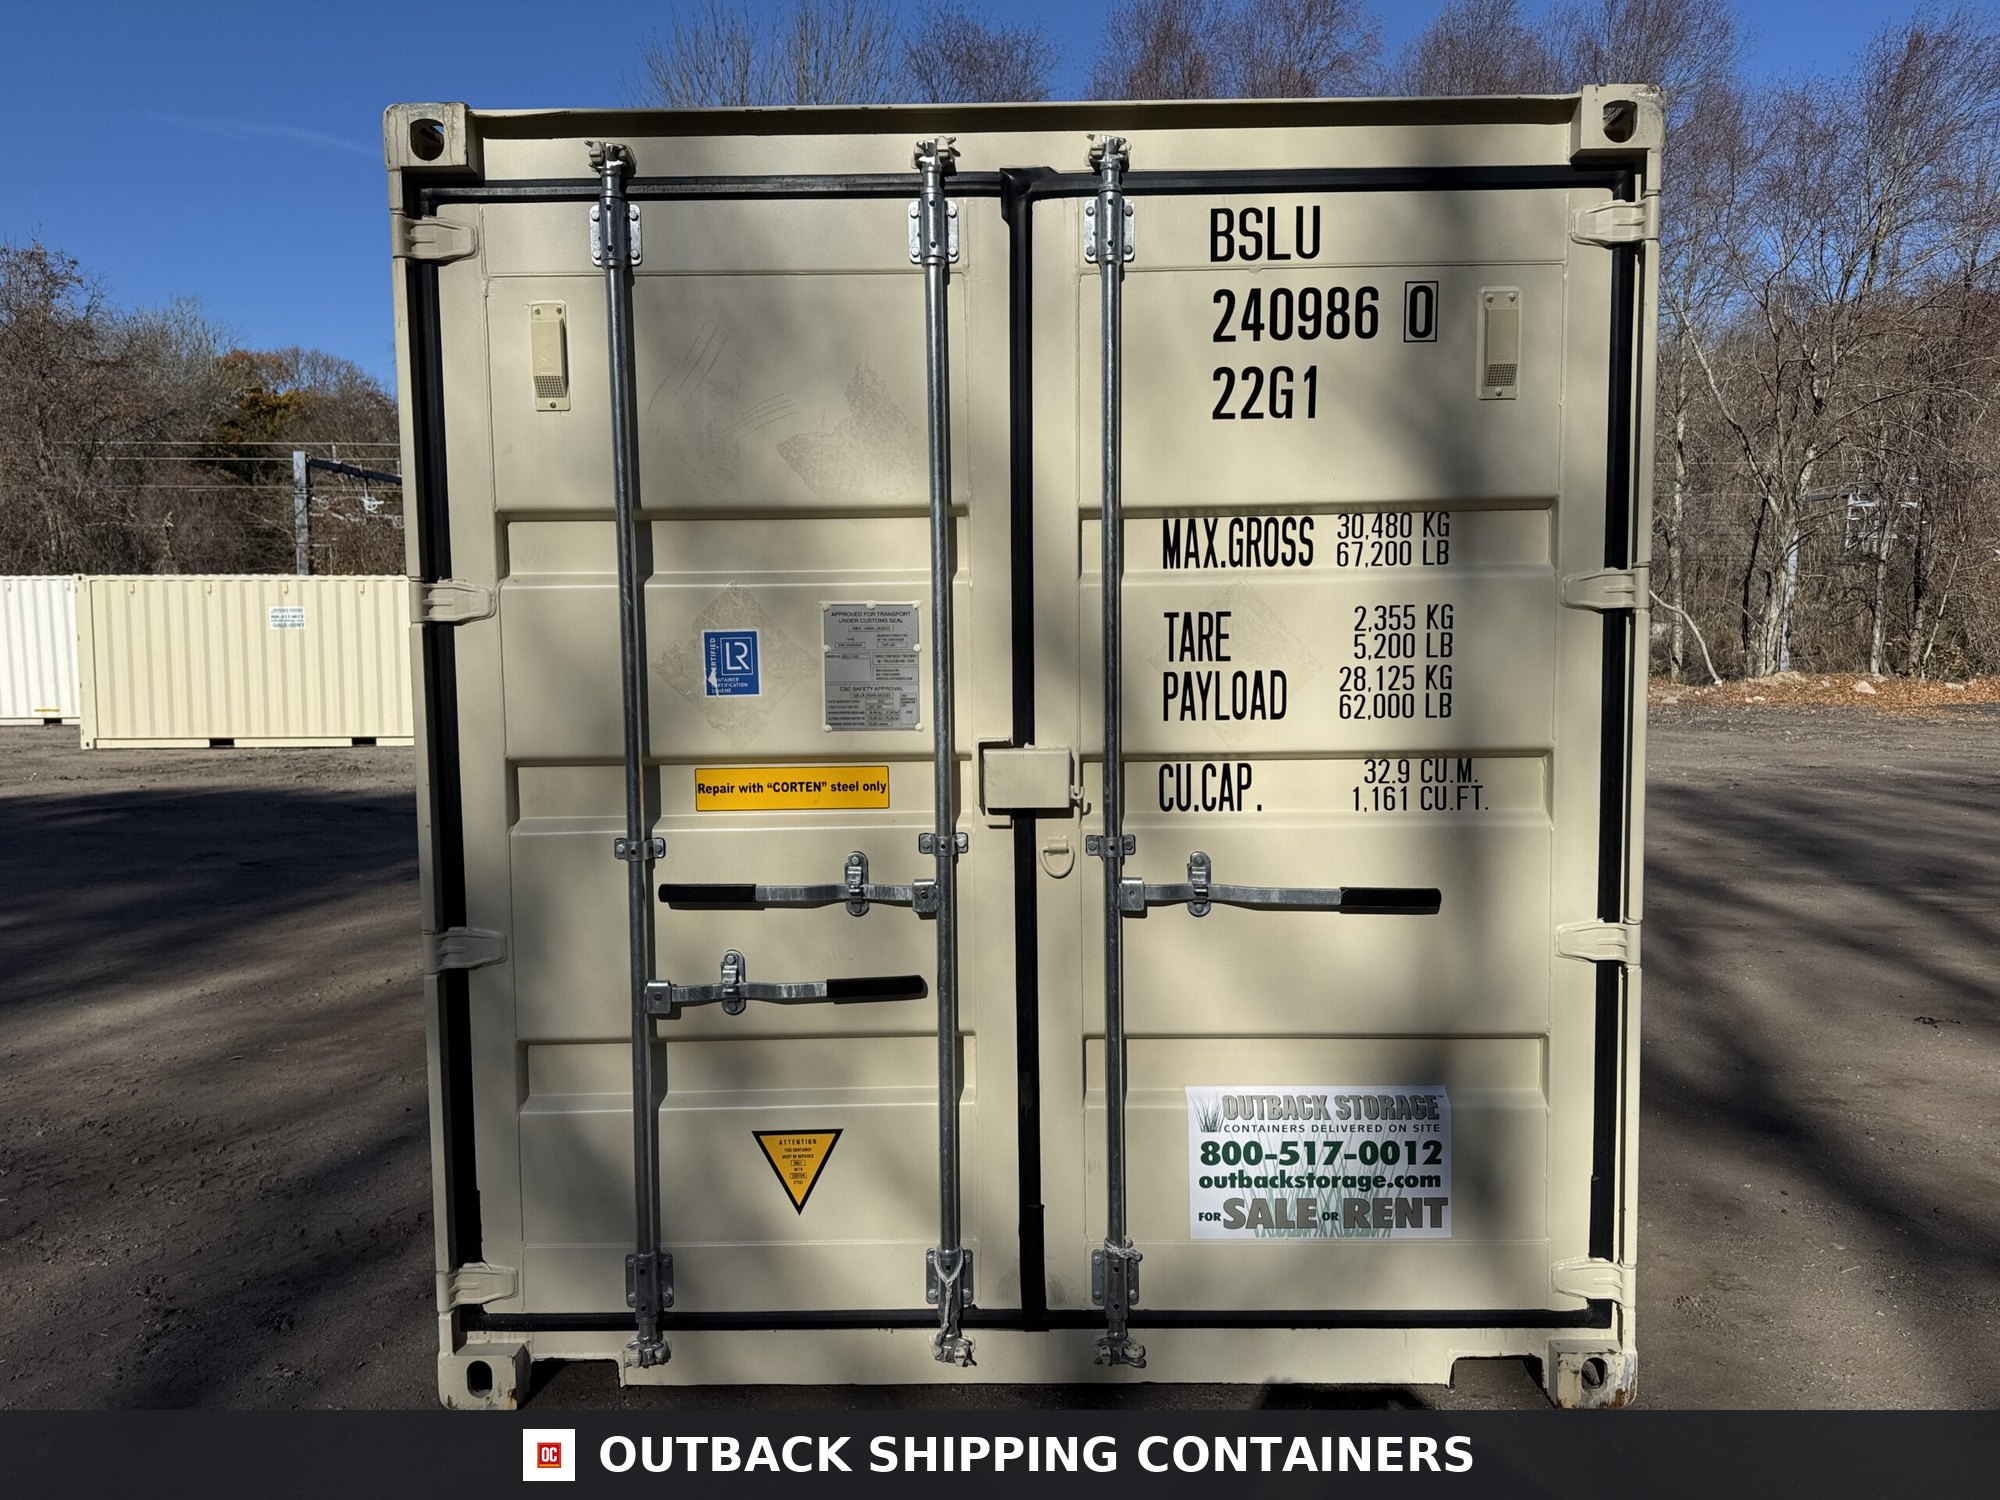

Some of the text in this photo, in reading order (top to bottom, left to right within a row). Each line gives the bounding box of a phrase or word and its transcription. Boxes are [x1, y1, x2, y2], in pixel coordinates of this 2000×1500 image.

[1210, 205, 1321, 262] BSLU
[1212, 284, 1434, 342] 240986 0
[1212, 365, 1317, 420] 22G1
[1336, 512, 1450, 540] 30,480 KG
[1162, 516, 1314, 569] MAX.GROSS
[1336, 539, 1449, 568] 67,200 LB
[1353, 603, 1454, 632] 2,355 KG
[1164, 611, 1232, 662] TARE
[1353, 632, 1453, 660] 5,200 LB
[725, 641, 750, 670] LR
[1339, 664, 1453, 692] 28,125 KG
[1163, 670, 1287, 721] PAYLOAD
[1339, 693, 1452, 720] 62,000 LB
[1364, 758, 1478, 784] 32.9 CU.M.
[697, 783, 735, 796] Repair
[738, 782, 764, 793] with
[830, 780, 859, 792] steel
[862, 781, 887, 794] only
[1353, 785, 1488, 812] 1,161 CU.FT.
[1222, 1095, 1331, 1121] OUTBACK
[1224, 1123, 1441, 1133] CONTAINERS DELIVERED ON SITE
[1200, 1140, 1442, 1166] 800-517-0012
[1198, 1169, 1441, 1192] outbackstorage.com
[1198, 1196, 1448, 1230] FOR SALE OR RENT
